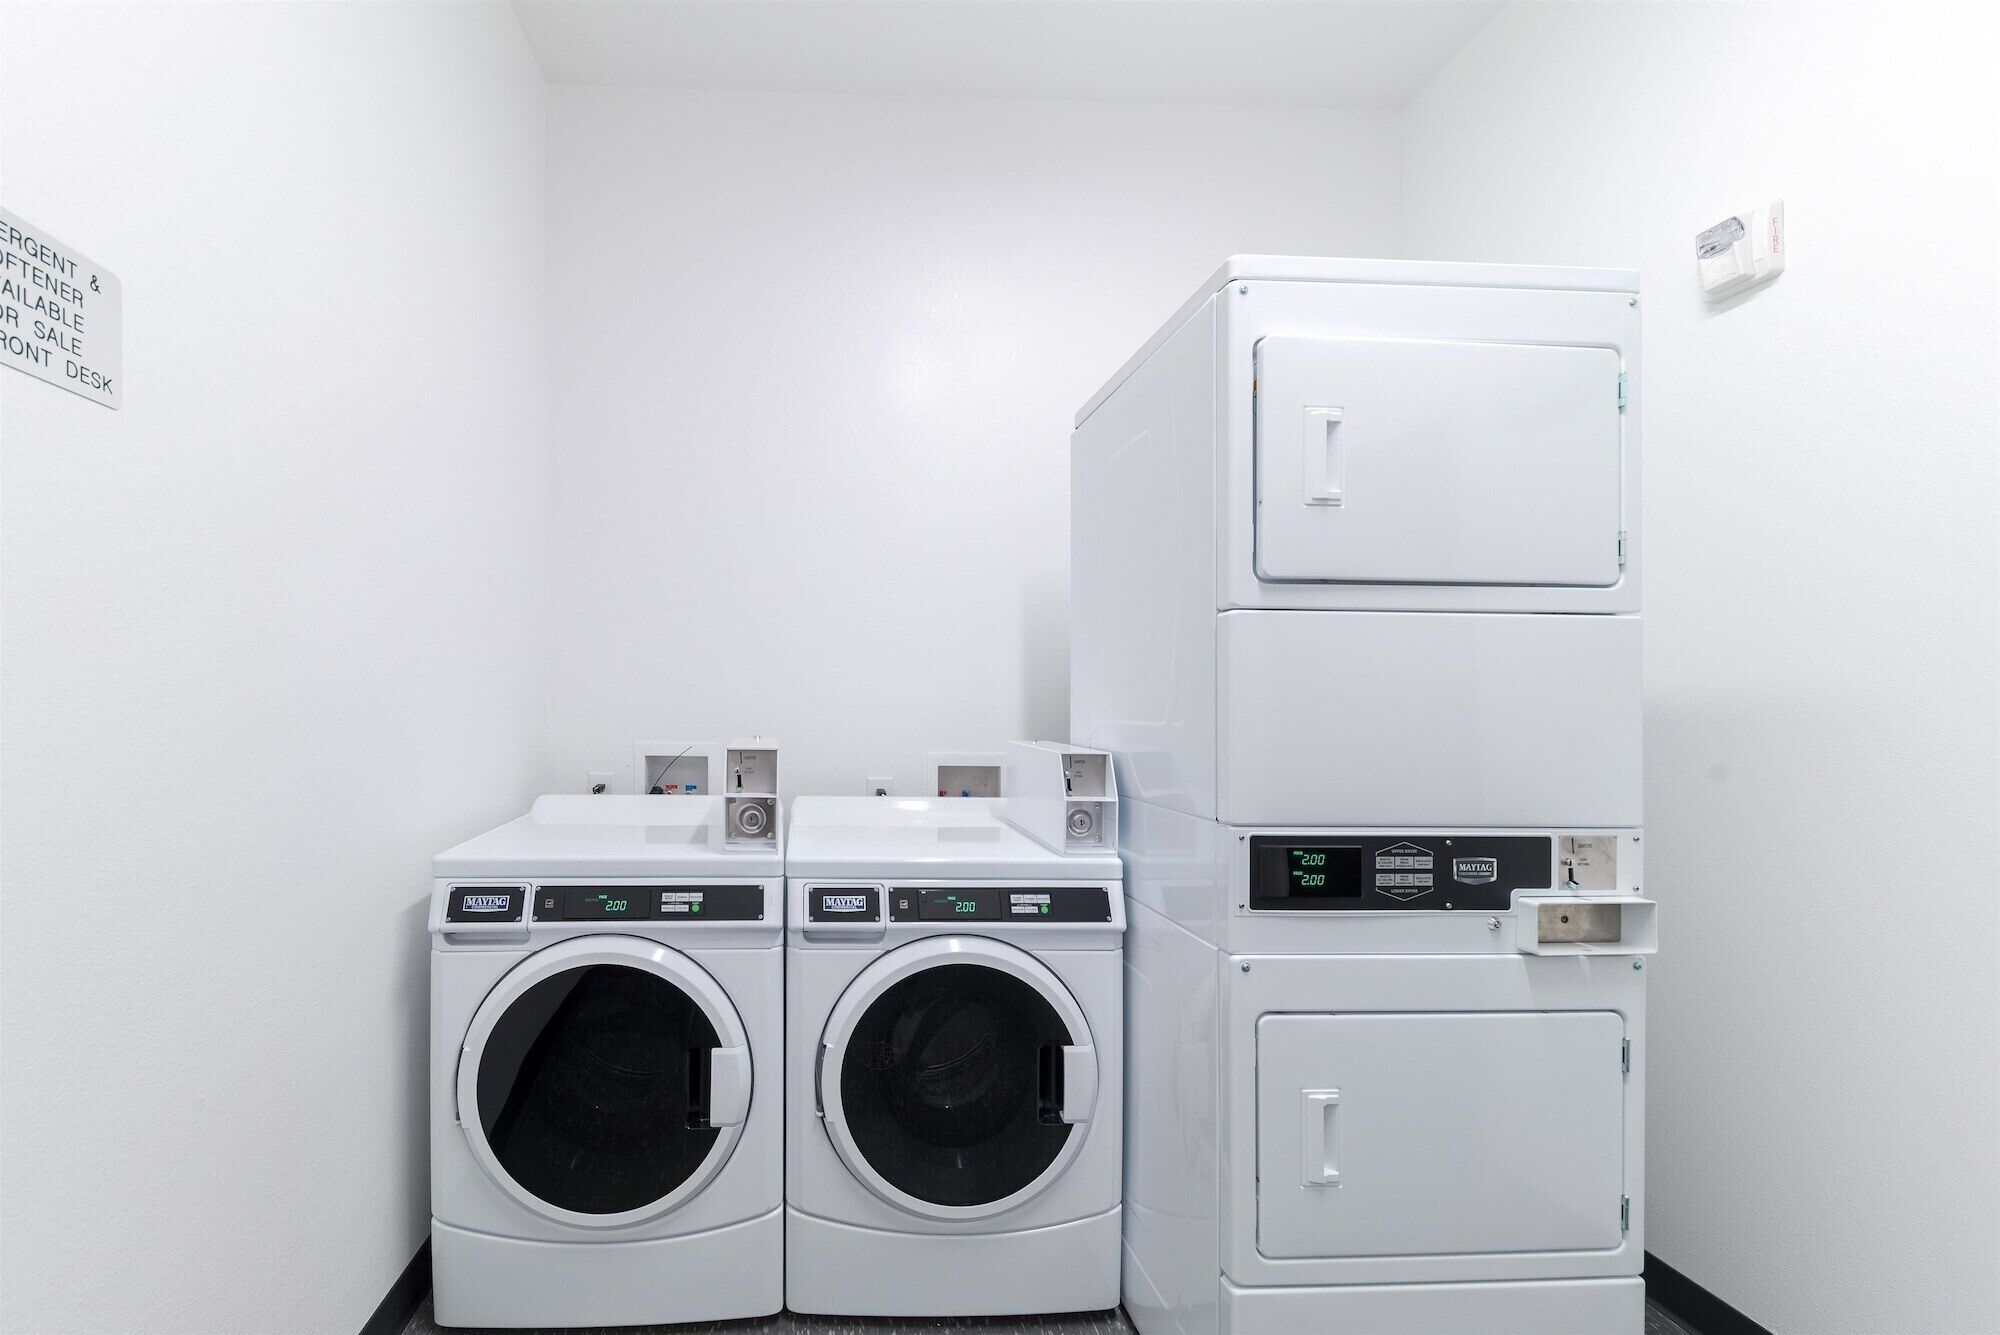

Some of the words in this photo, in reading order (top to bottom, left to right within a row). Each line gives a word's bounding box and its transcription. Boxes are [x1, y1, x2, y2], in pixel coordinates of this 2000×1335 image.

[0, 252, 83, 309] FTENER
[90, 275, 101, 294] &
[0, 274, 84, 334] AILABLE
[0, 305, 19, 328] R
[34, 320, 82, 357] SALE
[66, 360, 113, 394] DESK
[1301, 854, 1326, 866] 2.00
[1458, 863, 1493, 871] MAYTAG
[1301, 874, 1326, 886] 2.00
[466, 897, 506, 906] MAYTAG
[604, 900, 628, 911] 2.00
[825, 897, 864, 906] MAYTAG
[955, 901, 976, 912] 2.00
